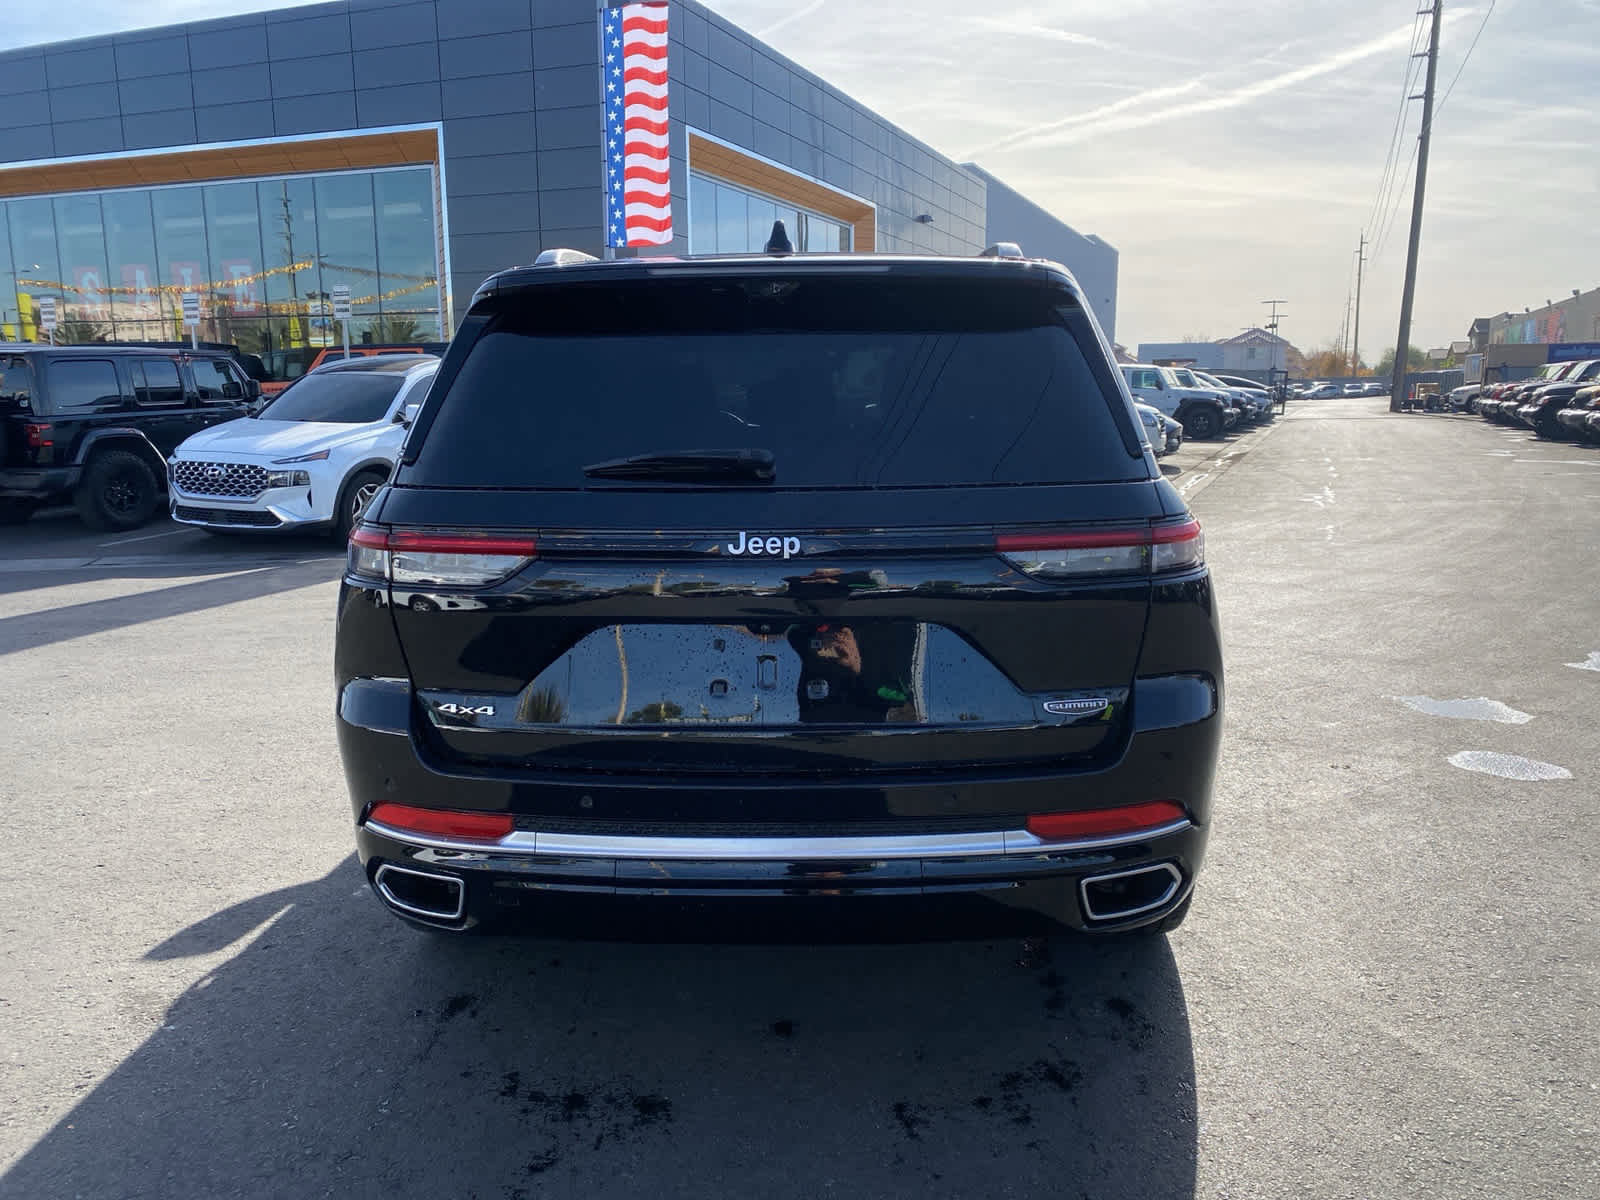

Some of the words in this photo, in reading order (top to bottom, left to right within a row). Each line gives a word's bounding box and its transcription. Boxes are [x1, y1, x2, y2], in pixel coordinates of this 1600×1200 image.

[728, 531, 801, 559] Jeep
[437, 703, 495, 716] 4x4
[1048, 700, 1106, 711] SUMMIT
